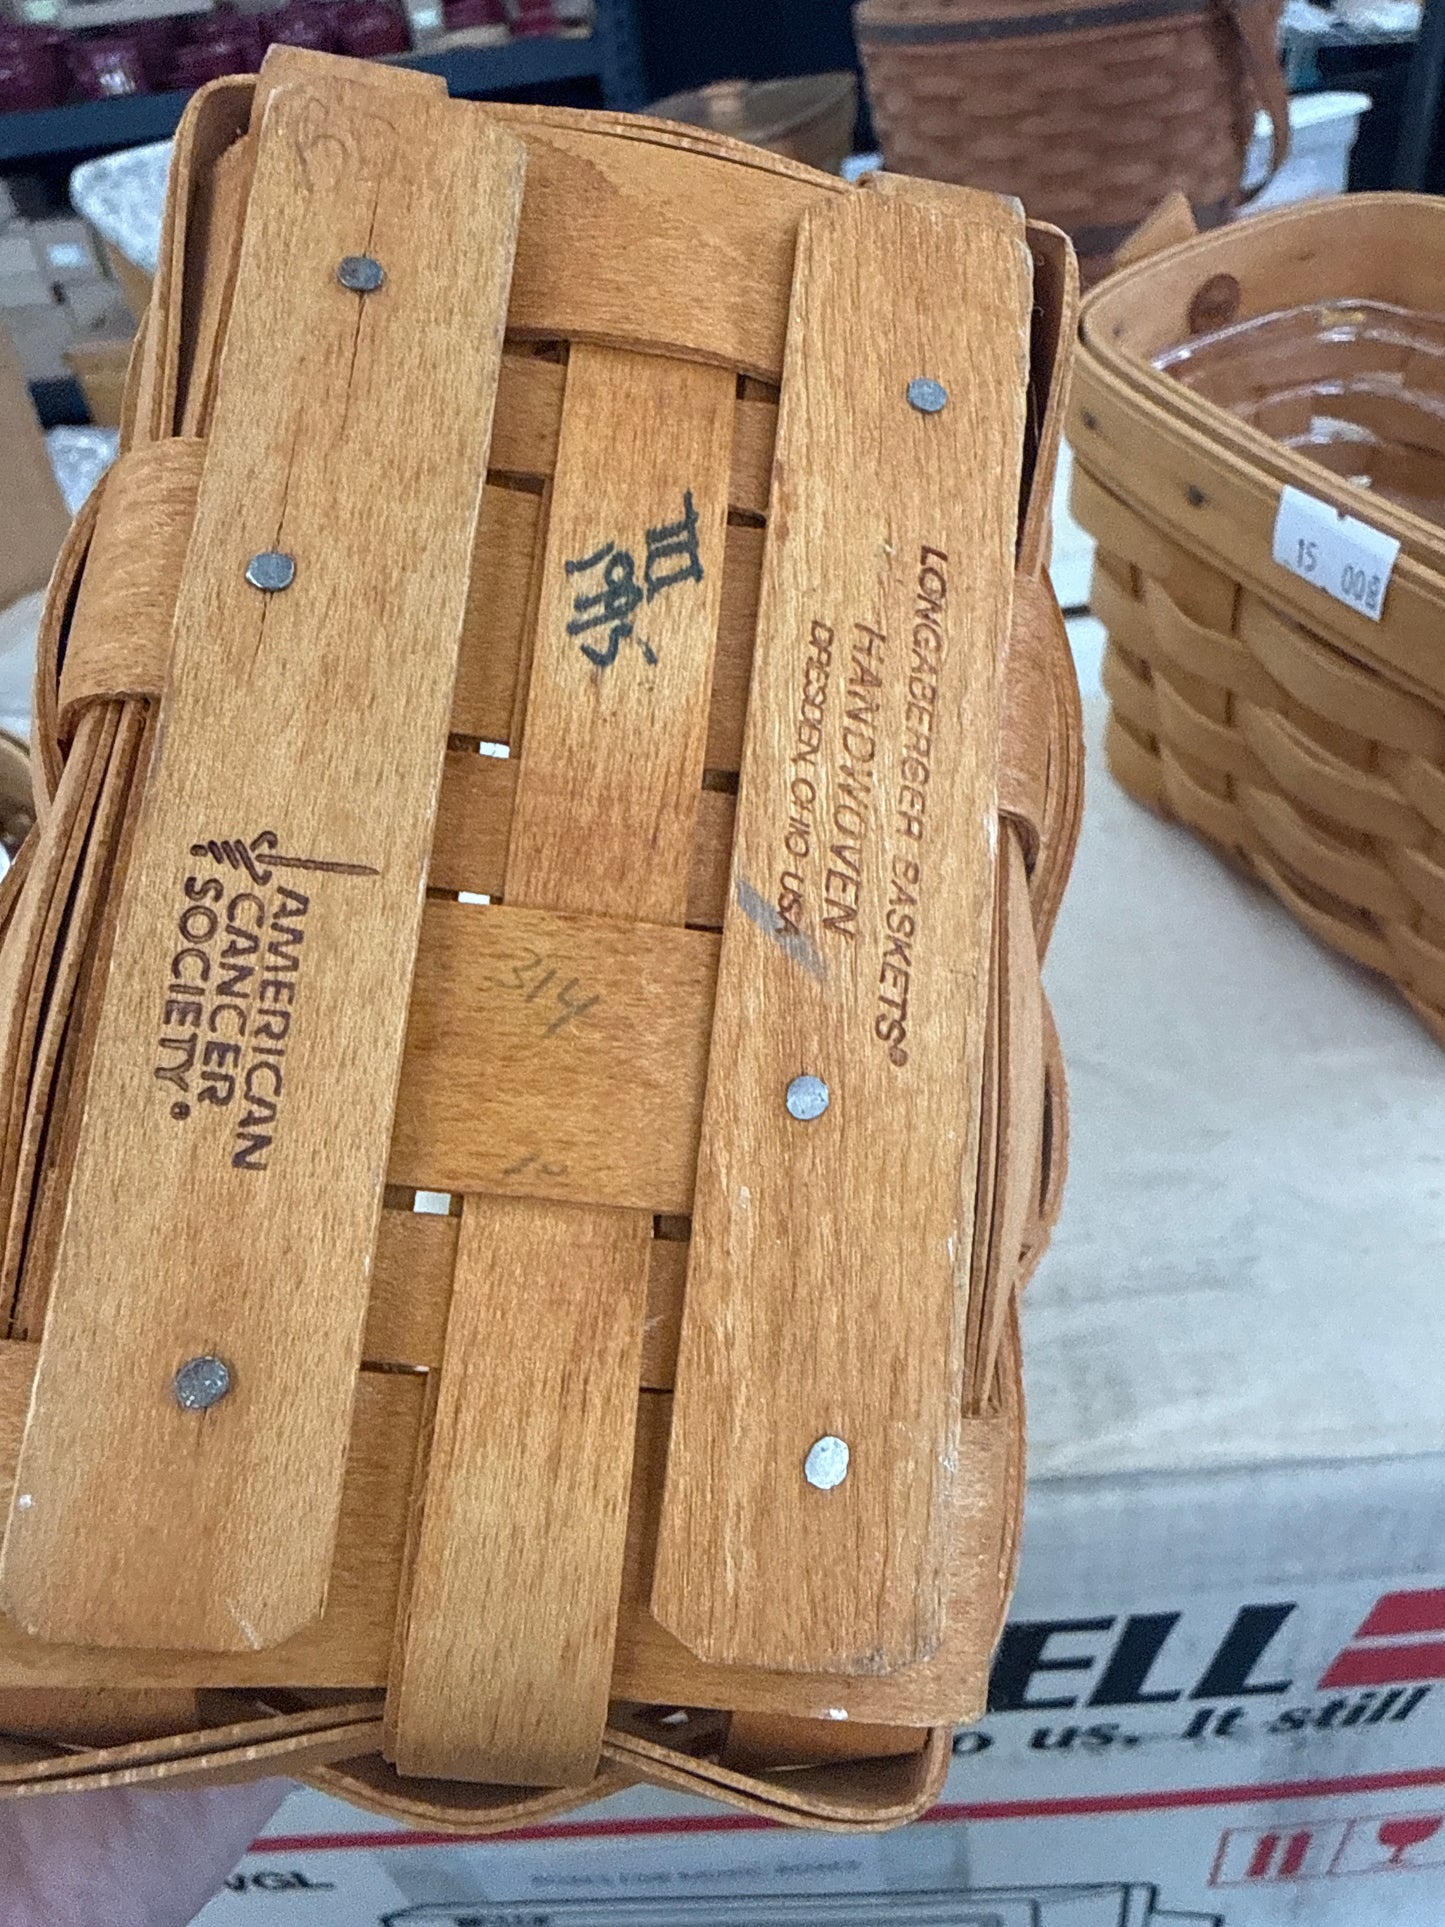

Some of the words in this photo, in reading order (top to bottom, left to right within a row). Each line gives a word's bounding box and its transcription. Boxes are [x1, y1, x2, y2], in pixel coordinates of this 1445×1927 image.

[1298, 538, 1317, 572] 15
[822, 621, 886, 942] HANDWOVEN
[896, 544, 948, 842] LONGABERGER
[784, 777, 817, 858] OHIO
[197, 893, 266, 1107] CANCER
[231, 885, 309, 1172] AMERICAN
[1266, 1684, 1432, 1733] still
